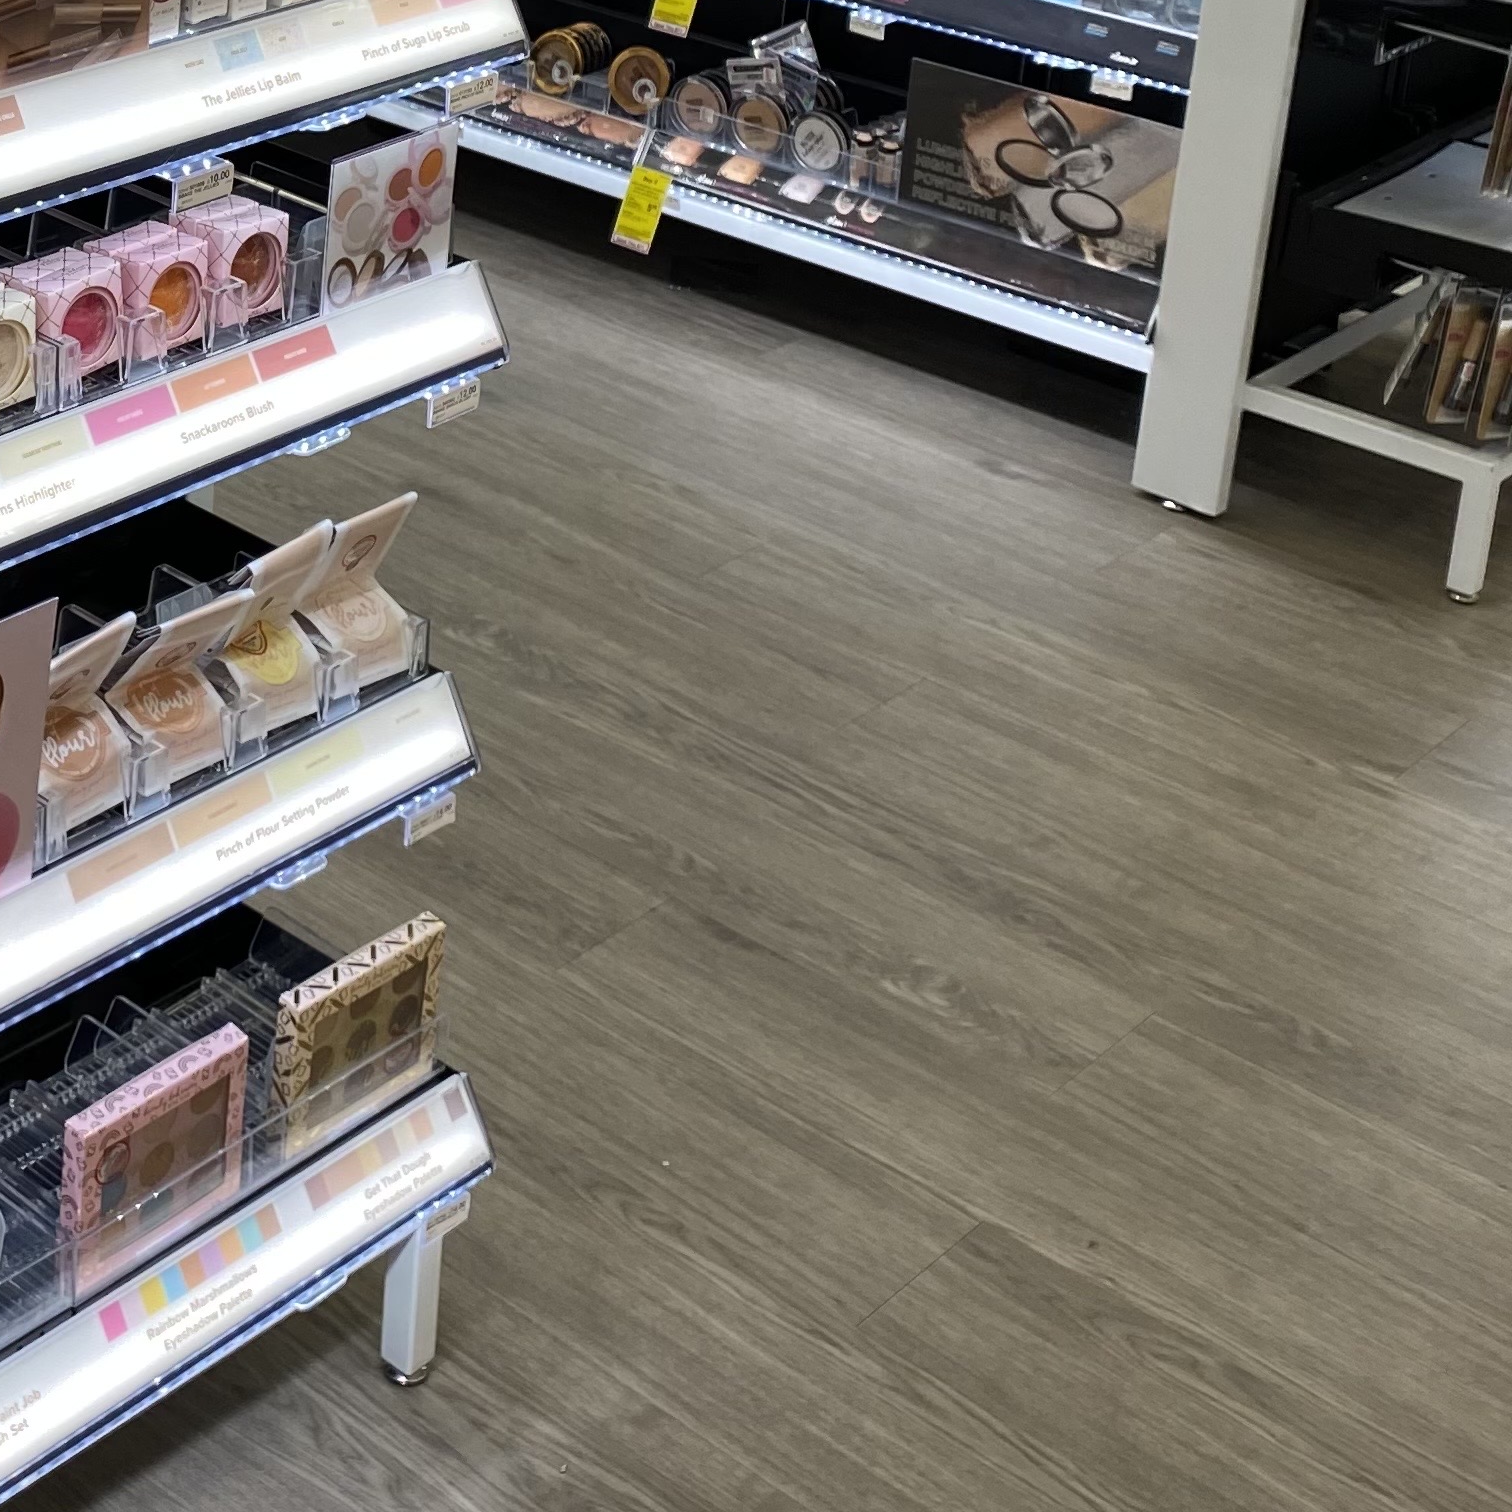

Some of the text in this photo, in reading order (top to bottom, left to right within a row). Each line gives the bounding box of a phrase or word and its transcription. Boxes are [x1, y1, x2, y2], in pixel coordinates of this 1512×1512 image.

[362, 21, 471, 61] Pinch Suga Lip Scrub
[201, 69, 302, 109] The Jellies Lip Balm
[180, 399, 276, 446] Snackaroons Blush
[216, 784, 351, 862] Pinch Flour Setting Powder
[163, 1311, 219, 1353] Eyeshadow
[21, 1389, 42, 1409] Job
[10, 1417, 30, 1437] Set
